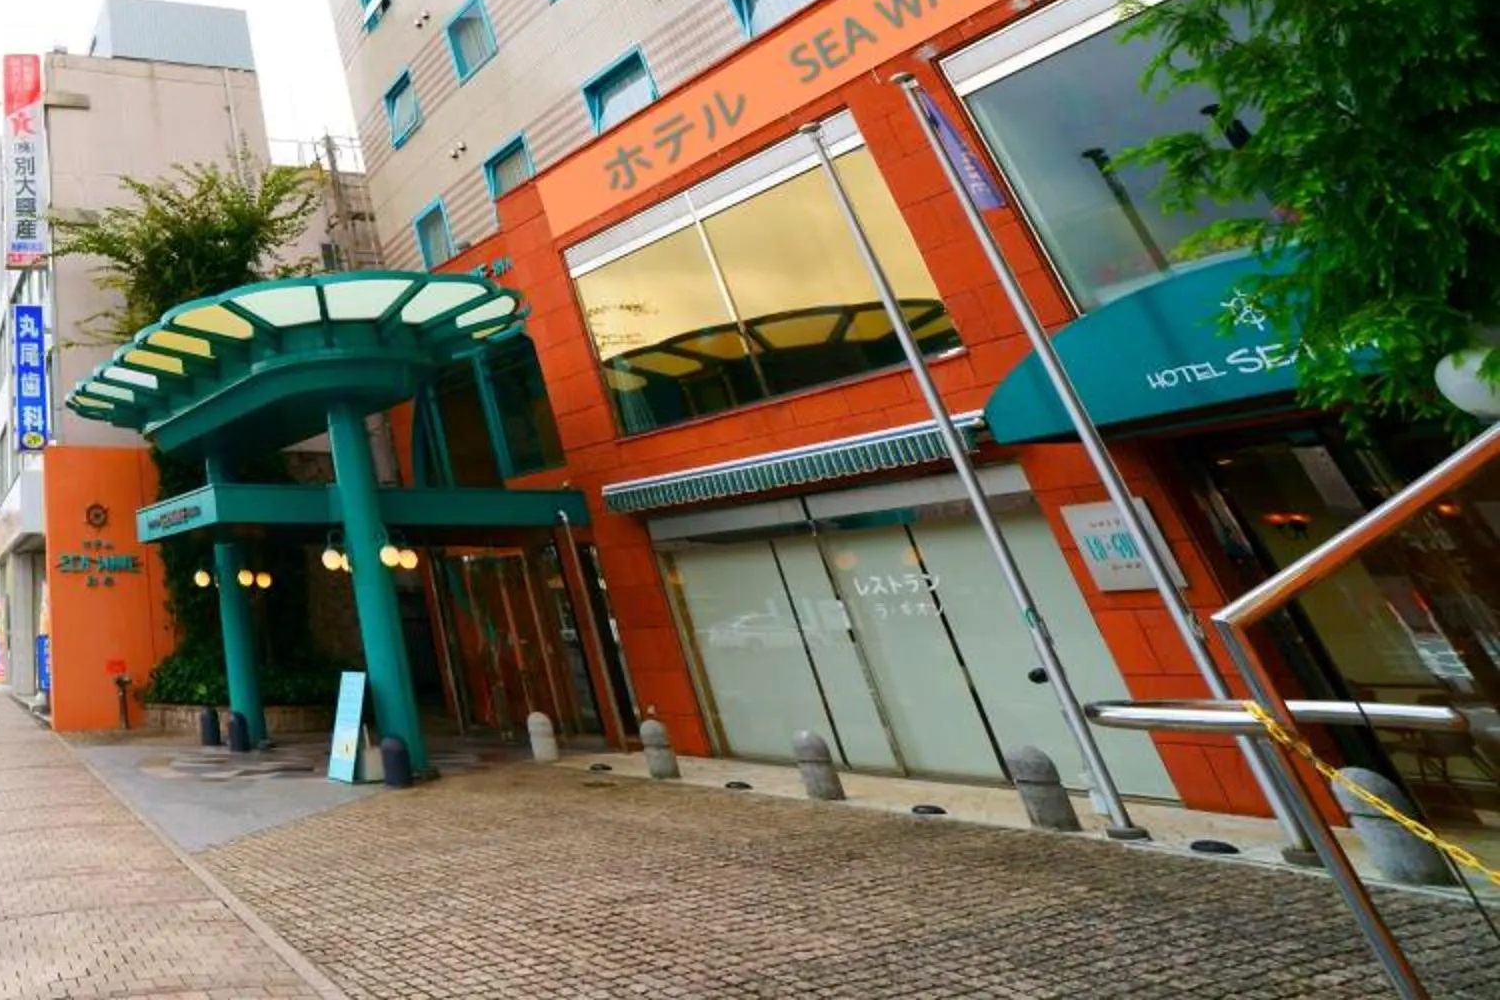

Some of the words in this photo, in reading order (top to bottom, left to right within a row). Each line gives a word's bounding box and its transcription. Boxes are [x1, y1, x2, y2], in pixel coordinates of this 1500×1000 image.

[603, 90, 747, 191] ホテル
[788, 15, 879, 84] SEA
[1146, 361, 1227, 389] HOTEL
[853, 574, 940, 597] レストラン
